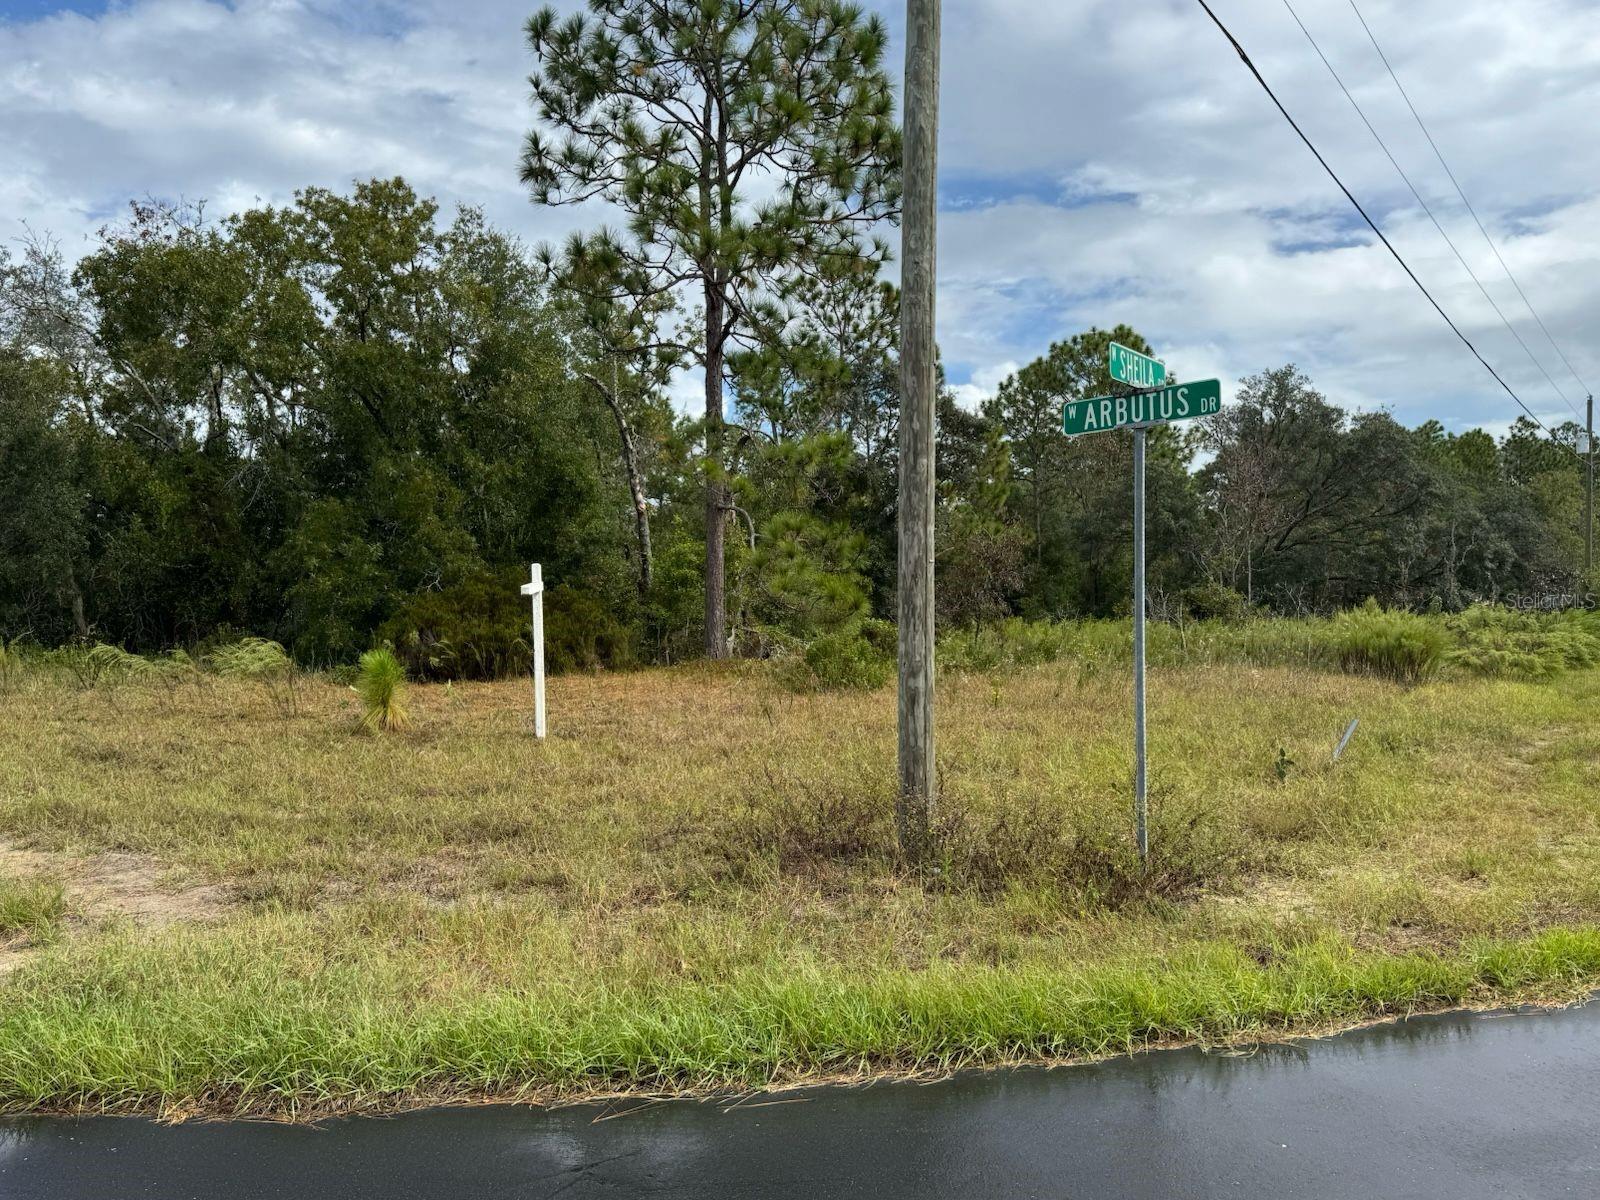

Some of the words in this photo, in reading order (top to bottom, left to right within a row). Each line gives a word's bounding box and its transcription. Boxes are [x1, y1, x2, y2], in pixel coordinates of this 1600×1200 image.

[1119, 350, 1155, 387] SHEILA
[1068, 405, 1077, 420] W
[1084, 387, 1190, 431] ARBUTUS
[1200, 396, 1217, 414] DR
